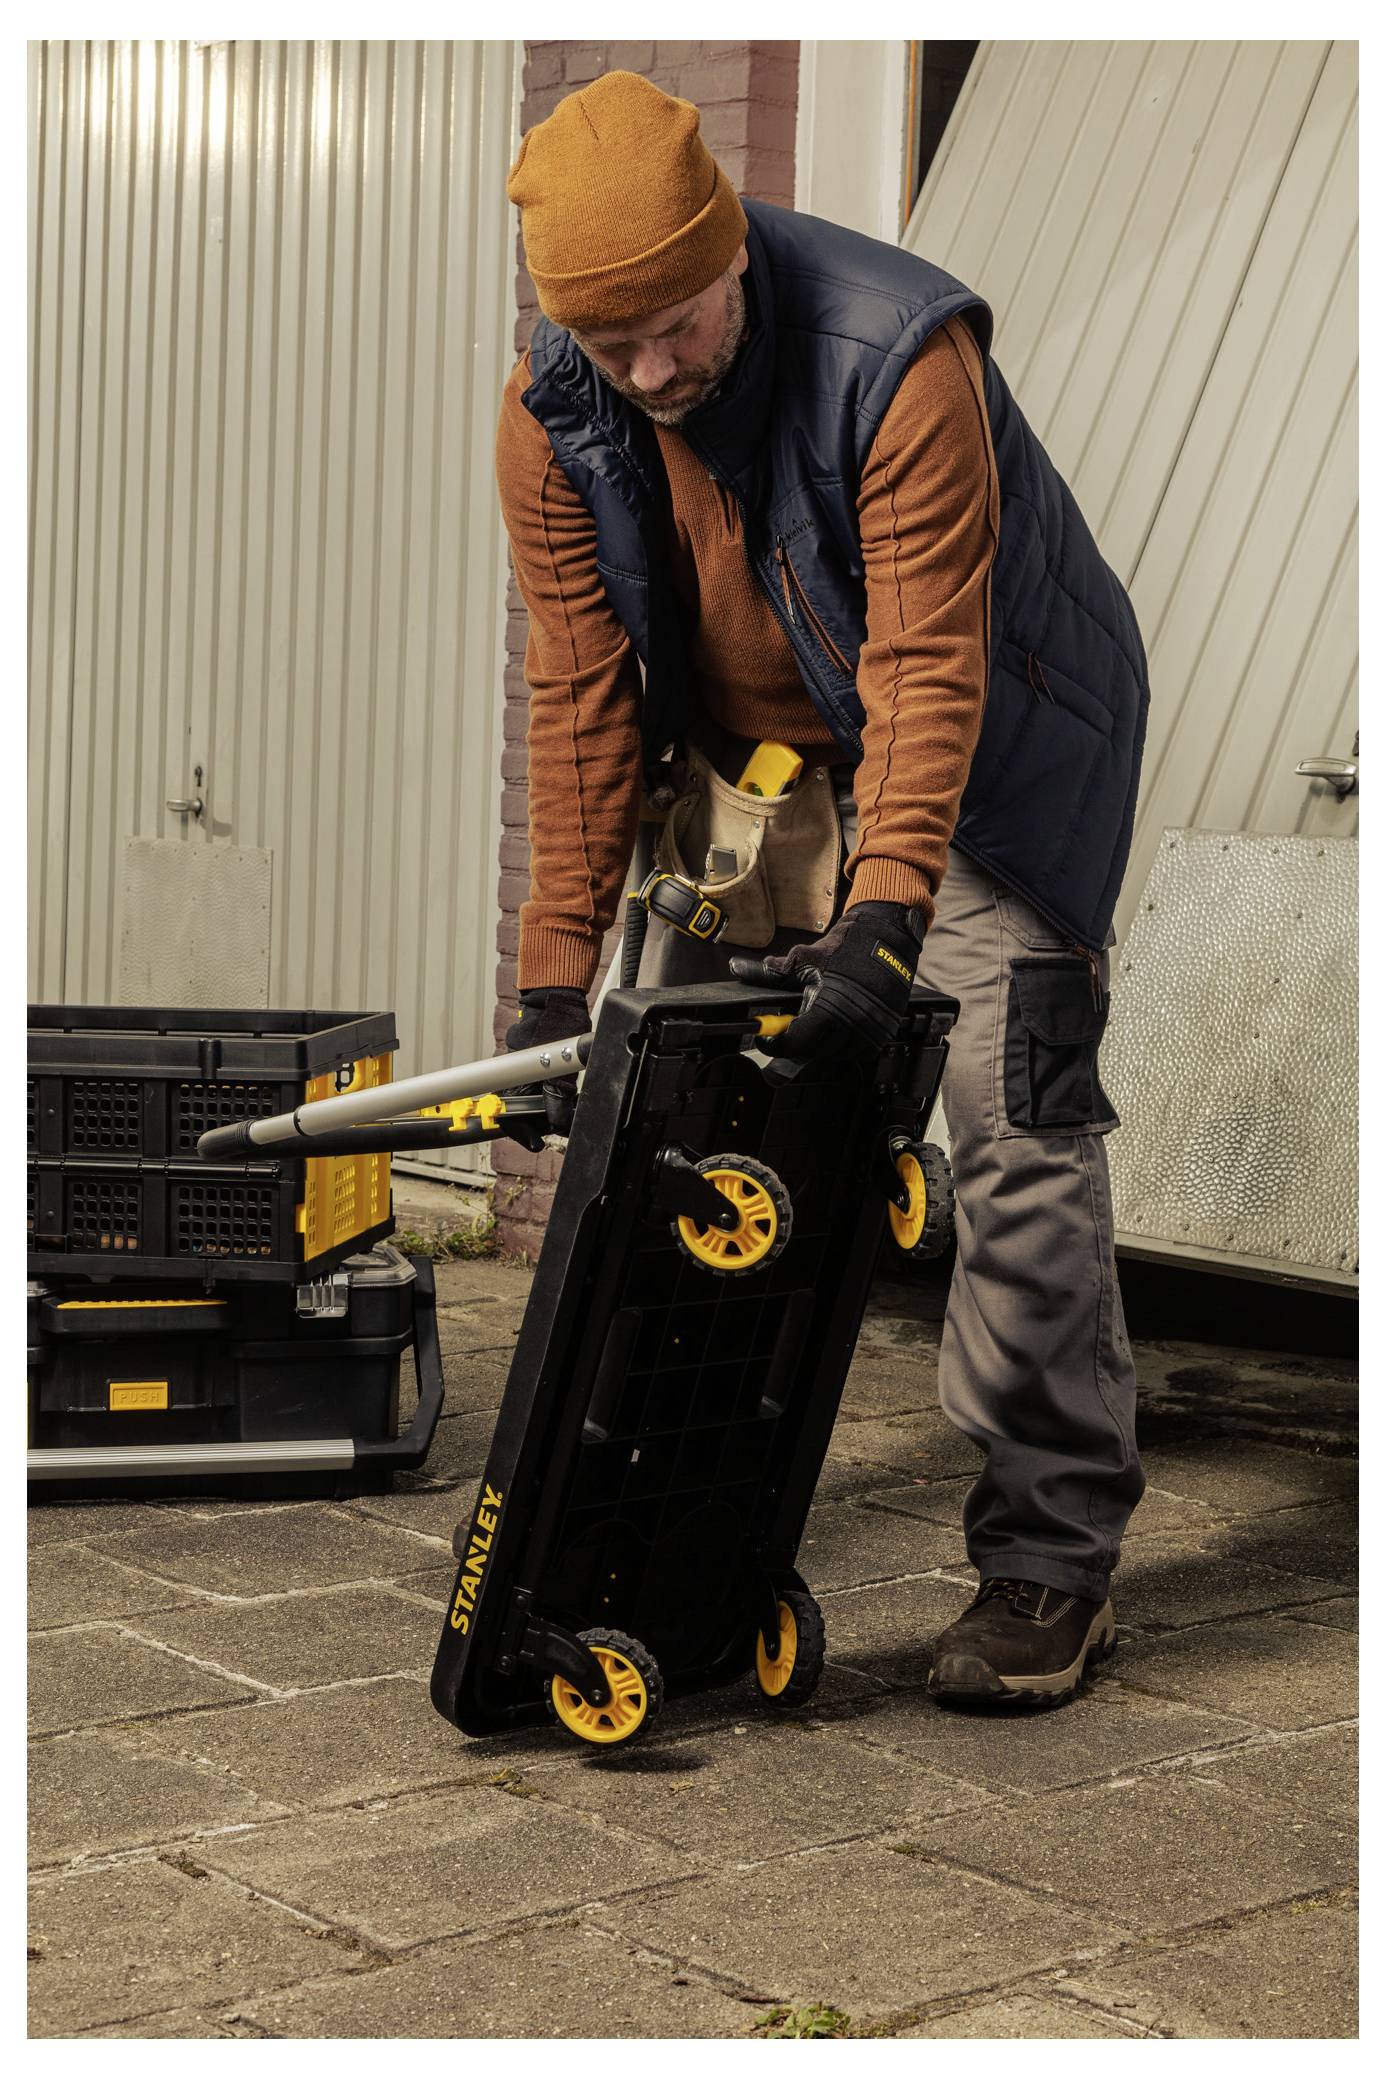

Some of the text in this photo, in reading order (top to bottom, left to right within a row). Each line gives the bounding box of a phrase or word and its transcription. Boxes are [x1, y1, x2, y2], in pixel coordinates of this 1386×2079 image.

[877, 947, 912, 982] STANLEY
[119, 1391, 160, 1404] PUSH
[450, 1483, 502, 1636] STANLEY
